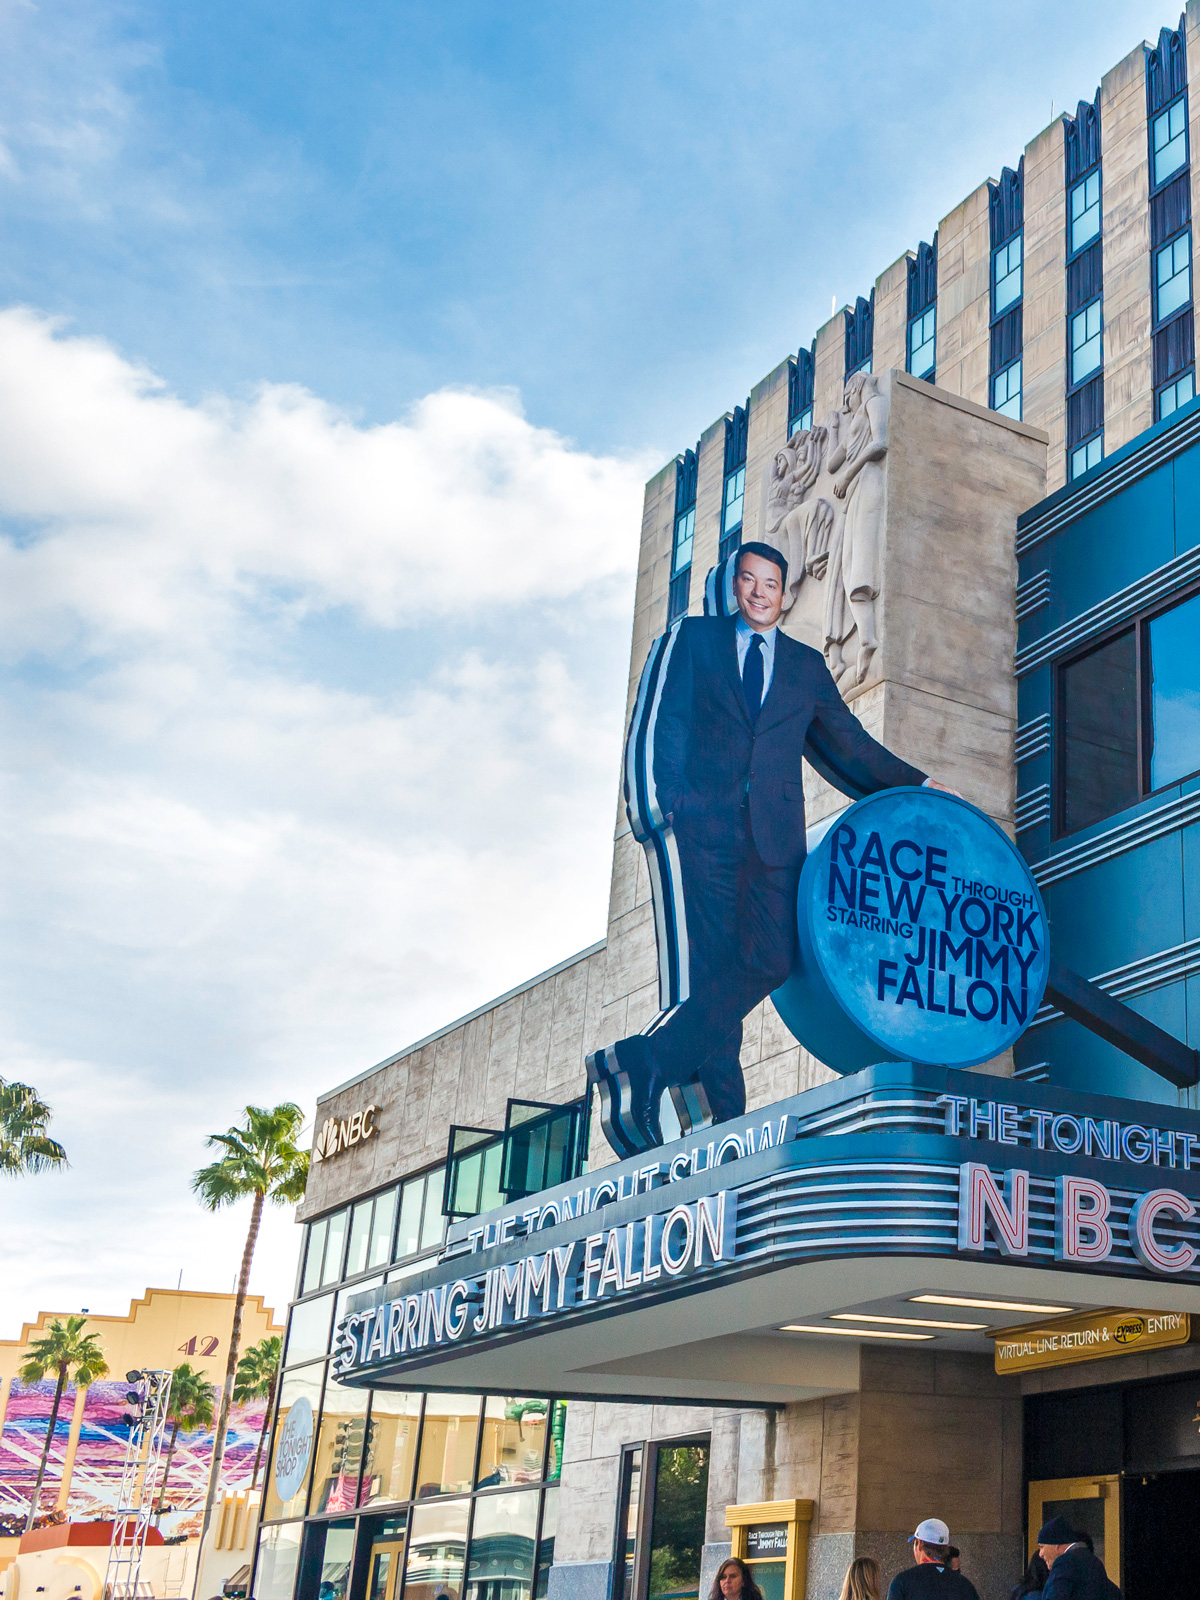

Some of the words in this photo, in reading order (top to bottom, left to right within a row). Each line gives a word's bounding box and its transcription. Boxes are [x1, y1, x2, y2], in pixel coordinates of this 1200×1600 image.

[830, 823, 947, 889] RACE
[828, 863, 927, 923] NEW
[937, 889, 1040, 950] YORK
[952, 876, 1033, 909] THROUGH
[827, 905, 913, 939] STARRING
[904, 926, 1037, 989] JIMMY
[877, 959, 1028, 1026] FALLON
[337, 1104, 377, 1152] NBC
[936, 1094, 1018, 1145] THE
[1025, 1108, 1197, 1170] TONIGHT
[958, 1161, 1198, 1274] NBC
[341, 1279, 473, 1368] STARRING
[474, 1242, 577, 1332] JIMMY
[583, 1190, 729, 1300] FALLON
[177, 1335, 220, 1358] 42
[998, 1342, 1035, 1360] VIRTUAL
[1036, 1336, 1058, 1354] LINE
[1060, 1328, 1100, 1349] RETURN
[1102, 1327, 1110, 1342] &
[1116, 1323, 1142, 1341] EXPRESS
[1147, 1313, 1182, 1333] ENTRY
[279, 1435, 313, 1459] TONIGHT
[281, 1421, 297, 1440] THE
[275, 1457, 297, 1478] SHOP
[757, 1538, 774, 1549] JIMMY
